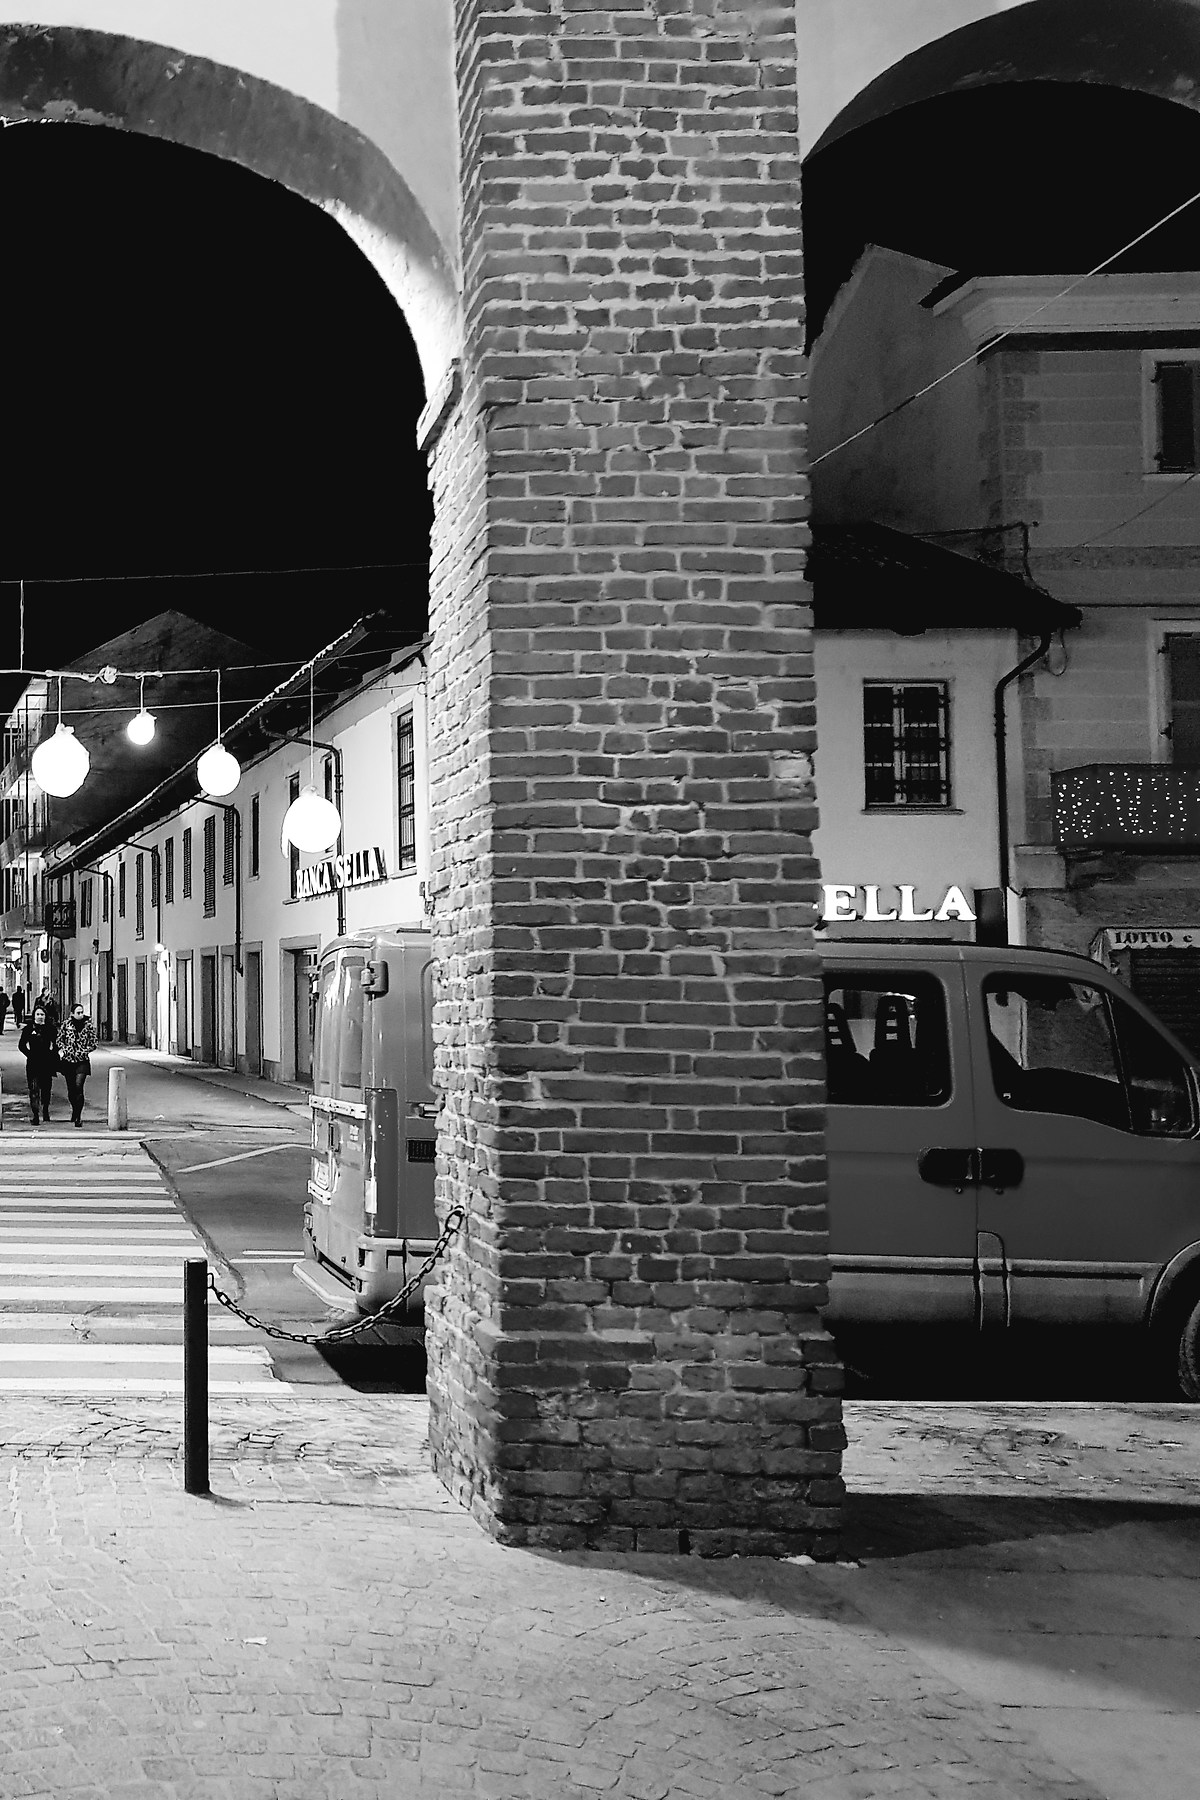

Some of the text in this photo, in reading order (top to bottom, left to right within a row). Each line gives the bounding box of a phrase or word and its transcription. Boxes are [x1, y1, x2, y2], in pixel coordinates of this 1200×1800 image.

[296, 847, 383, 899] BANCA SELLA
[1115, 931, 1174, 944] LOTTO
